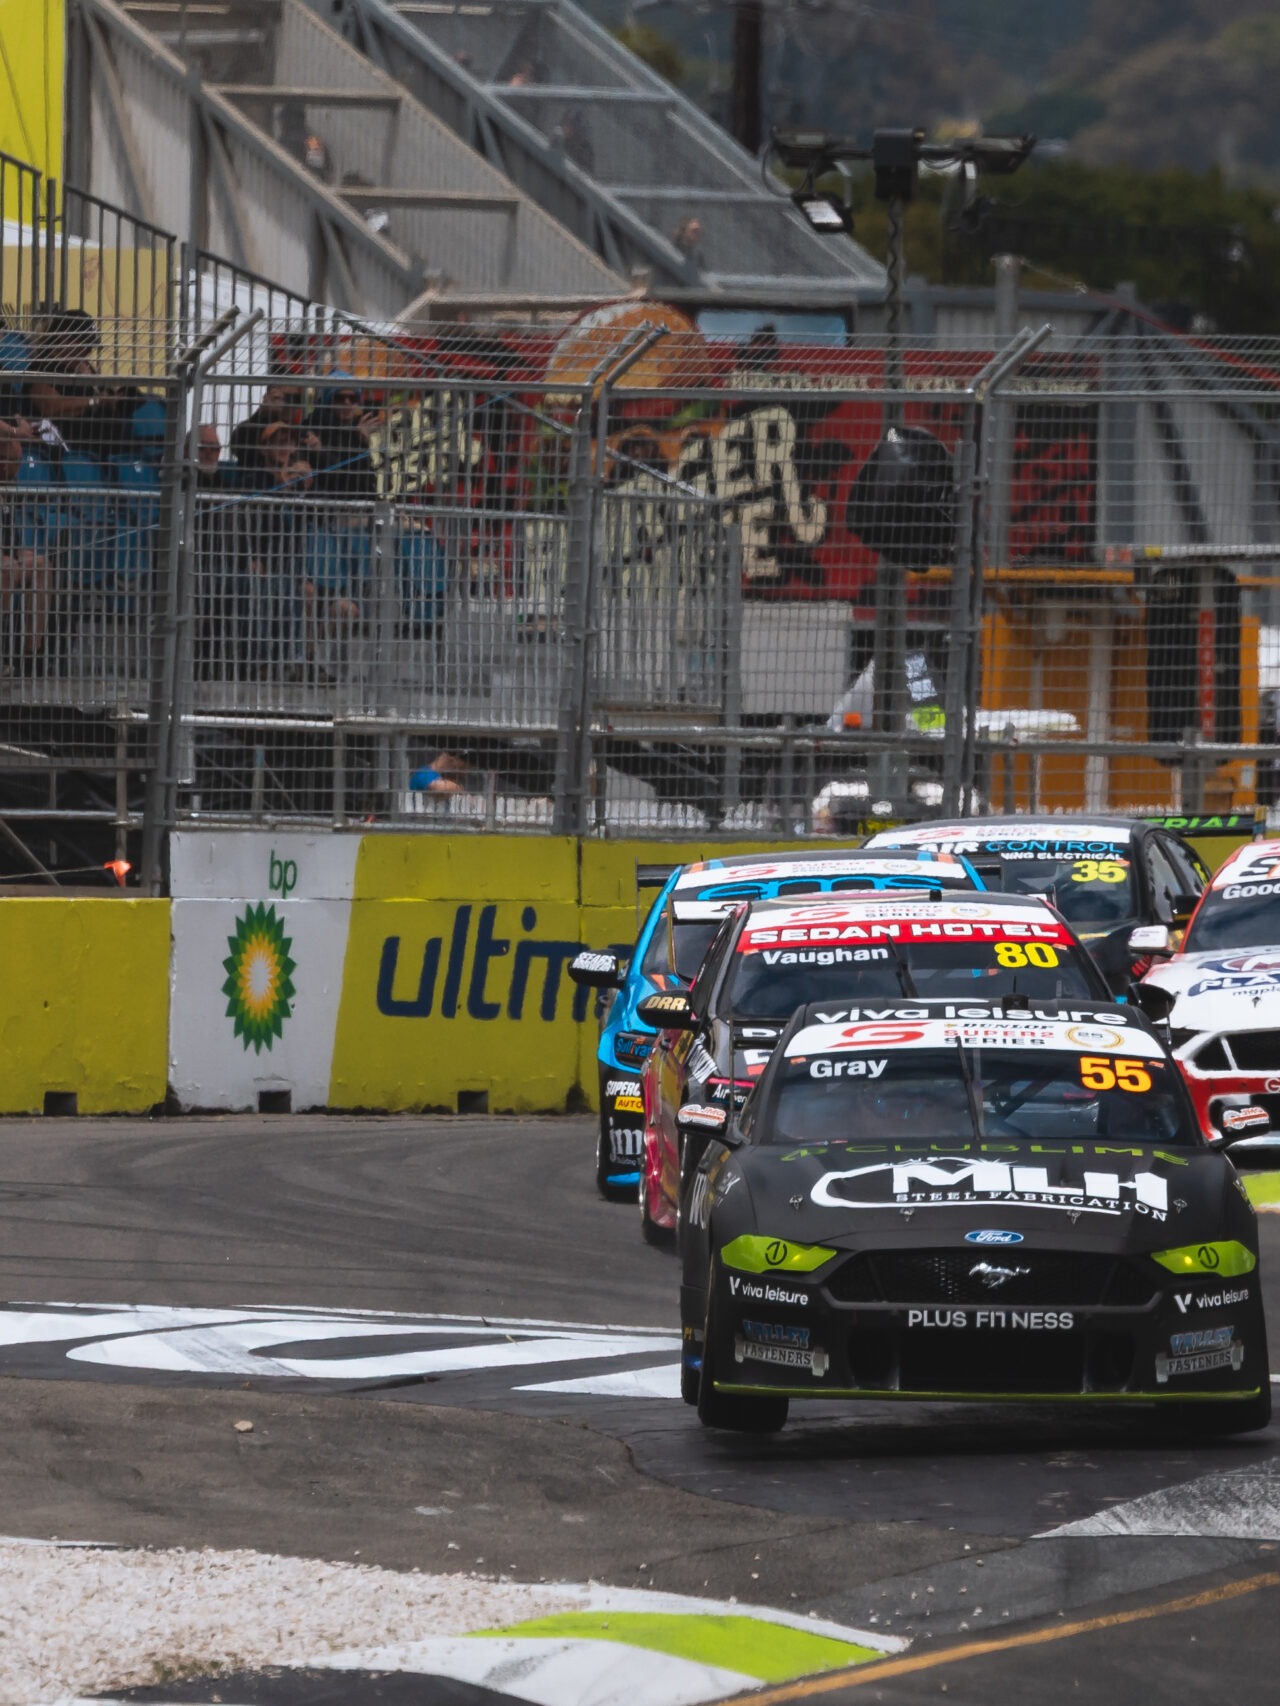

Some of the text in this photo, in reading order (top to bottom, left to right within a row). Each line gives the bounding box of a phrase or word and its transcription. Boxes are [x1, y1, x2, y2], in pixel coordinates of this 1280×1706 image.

[986, 841, 1125, 854] CONTROL
[1037, 853, 1124, 861] ELECTRICAL
[269, 849, 298, 900] bp
[1071, 861, 1128, 883] 35
[750, 922, 1059, 944] SEDAN HOTEL
[376, 904, 637, 1023] ultim
[762, 947, 889, 966] Vaughan
[995, 942, 1059, 968] 80
[814, 1006, 1129, 1026] viva leisure
[943, 1037, 1046, 1046] SERIES
[809, 1058, 889, 1079] Gray
[1079, 1056, 1152, 1092] 55
[895, 1190, 1168, 1223] STEEL FABRICATION
[974, 1231, 1013, 1243] Ford
[742, 1283, 763, 1299] viva
[765, 1283, 809, 1306] leisure
[1196, 1295, 1221, 1309] viva
[1222, 1289, 1250, 1305] leisure
[907, 1309, 967, 1329] PLUS
[742, 1319, 811, 1350] VALLEY
[1170, 1325, 1236, 1356] VALLEY
[744, 1342, 812, 1367] FASTENERS
[1168, 1351, 1232, 1374] FASTENERS
